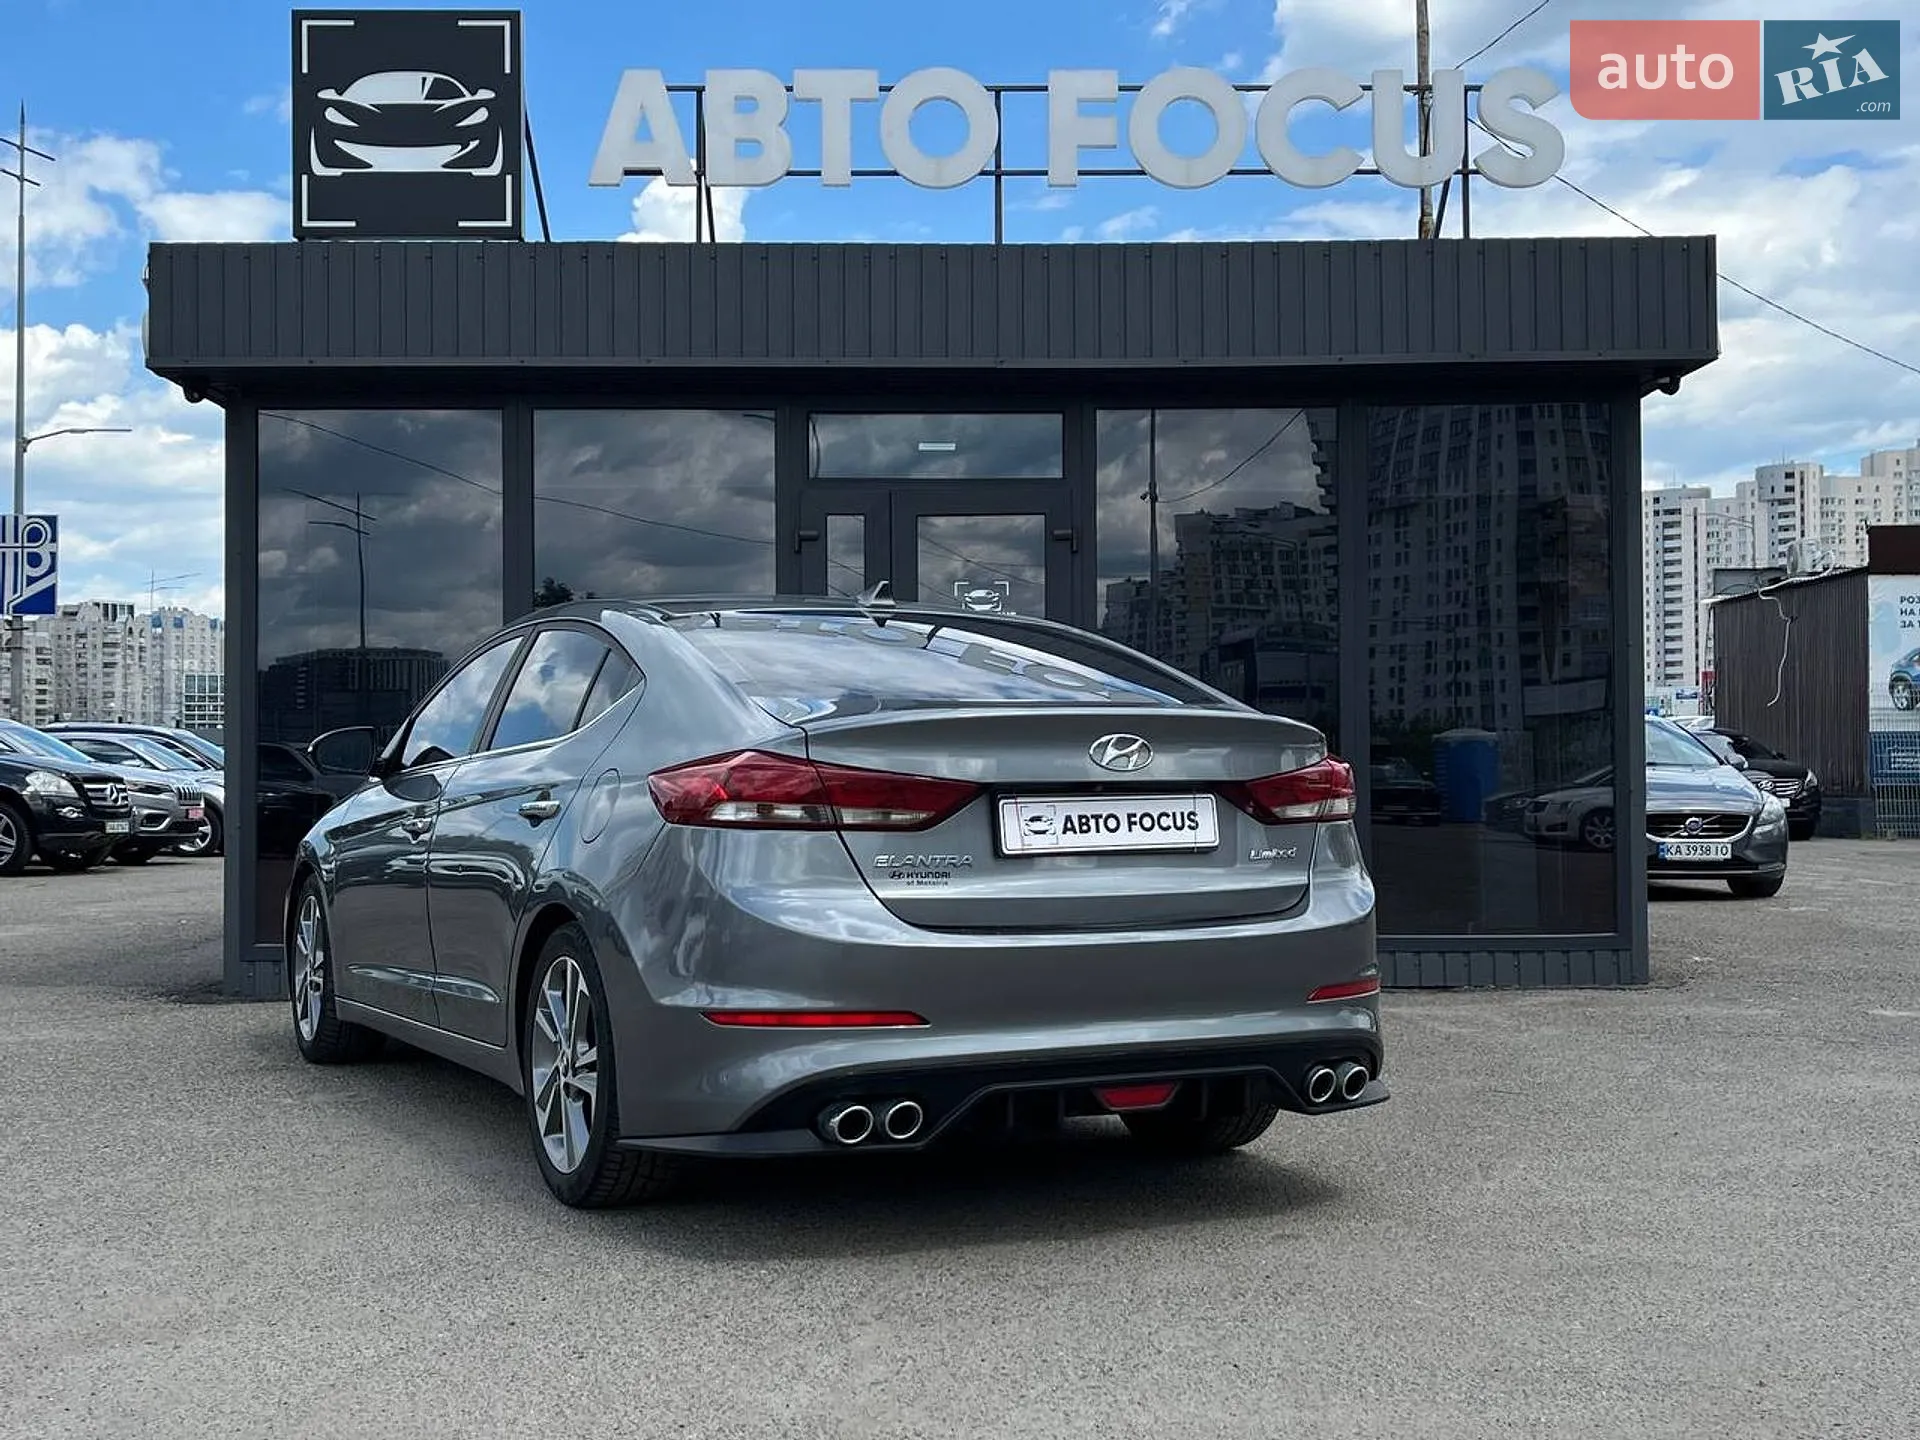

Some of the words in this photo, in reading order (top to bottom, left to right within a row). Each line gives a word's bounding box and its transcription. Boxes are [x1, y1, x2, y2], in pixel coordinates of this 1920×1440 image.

[588, 67, 999, 189] АВТО
[1047, 66, 1565, 189] FOCUS
[1126, 809, 1200, 832] FOCUS
[1685, 844, 1711, 856] 3938
[873, 854, 973, 868] ELANTRA
[906, 871, 951, 879] HYUNDAI
